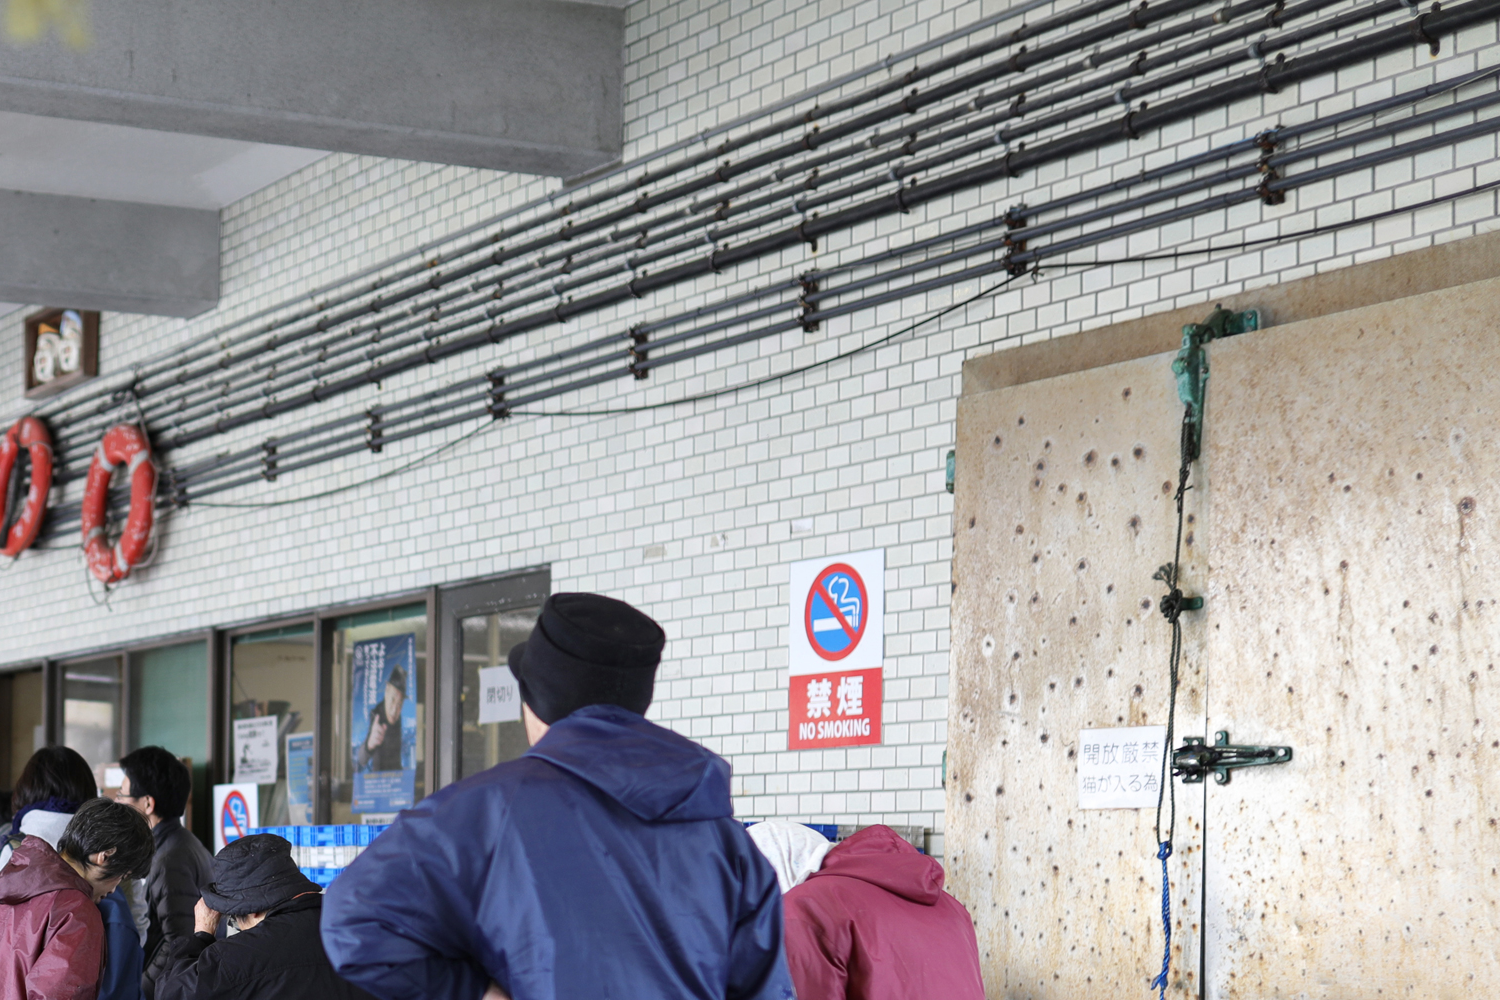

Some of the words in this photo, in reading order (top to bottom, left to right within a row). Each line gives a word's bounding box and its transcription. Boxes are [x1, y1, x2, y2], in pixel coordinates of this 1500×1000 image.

[806, 675, 864, 719] 禁煙
[799, 722, 816, 741] NO
[817, 718, 870, 740] SMOKING
[1083, 741, 1160, 766] 開放厳禁
[1082, 772, 1159, 794] 猫が入る為
